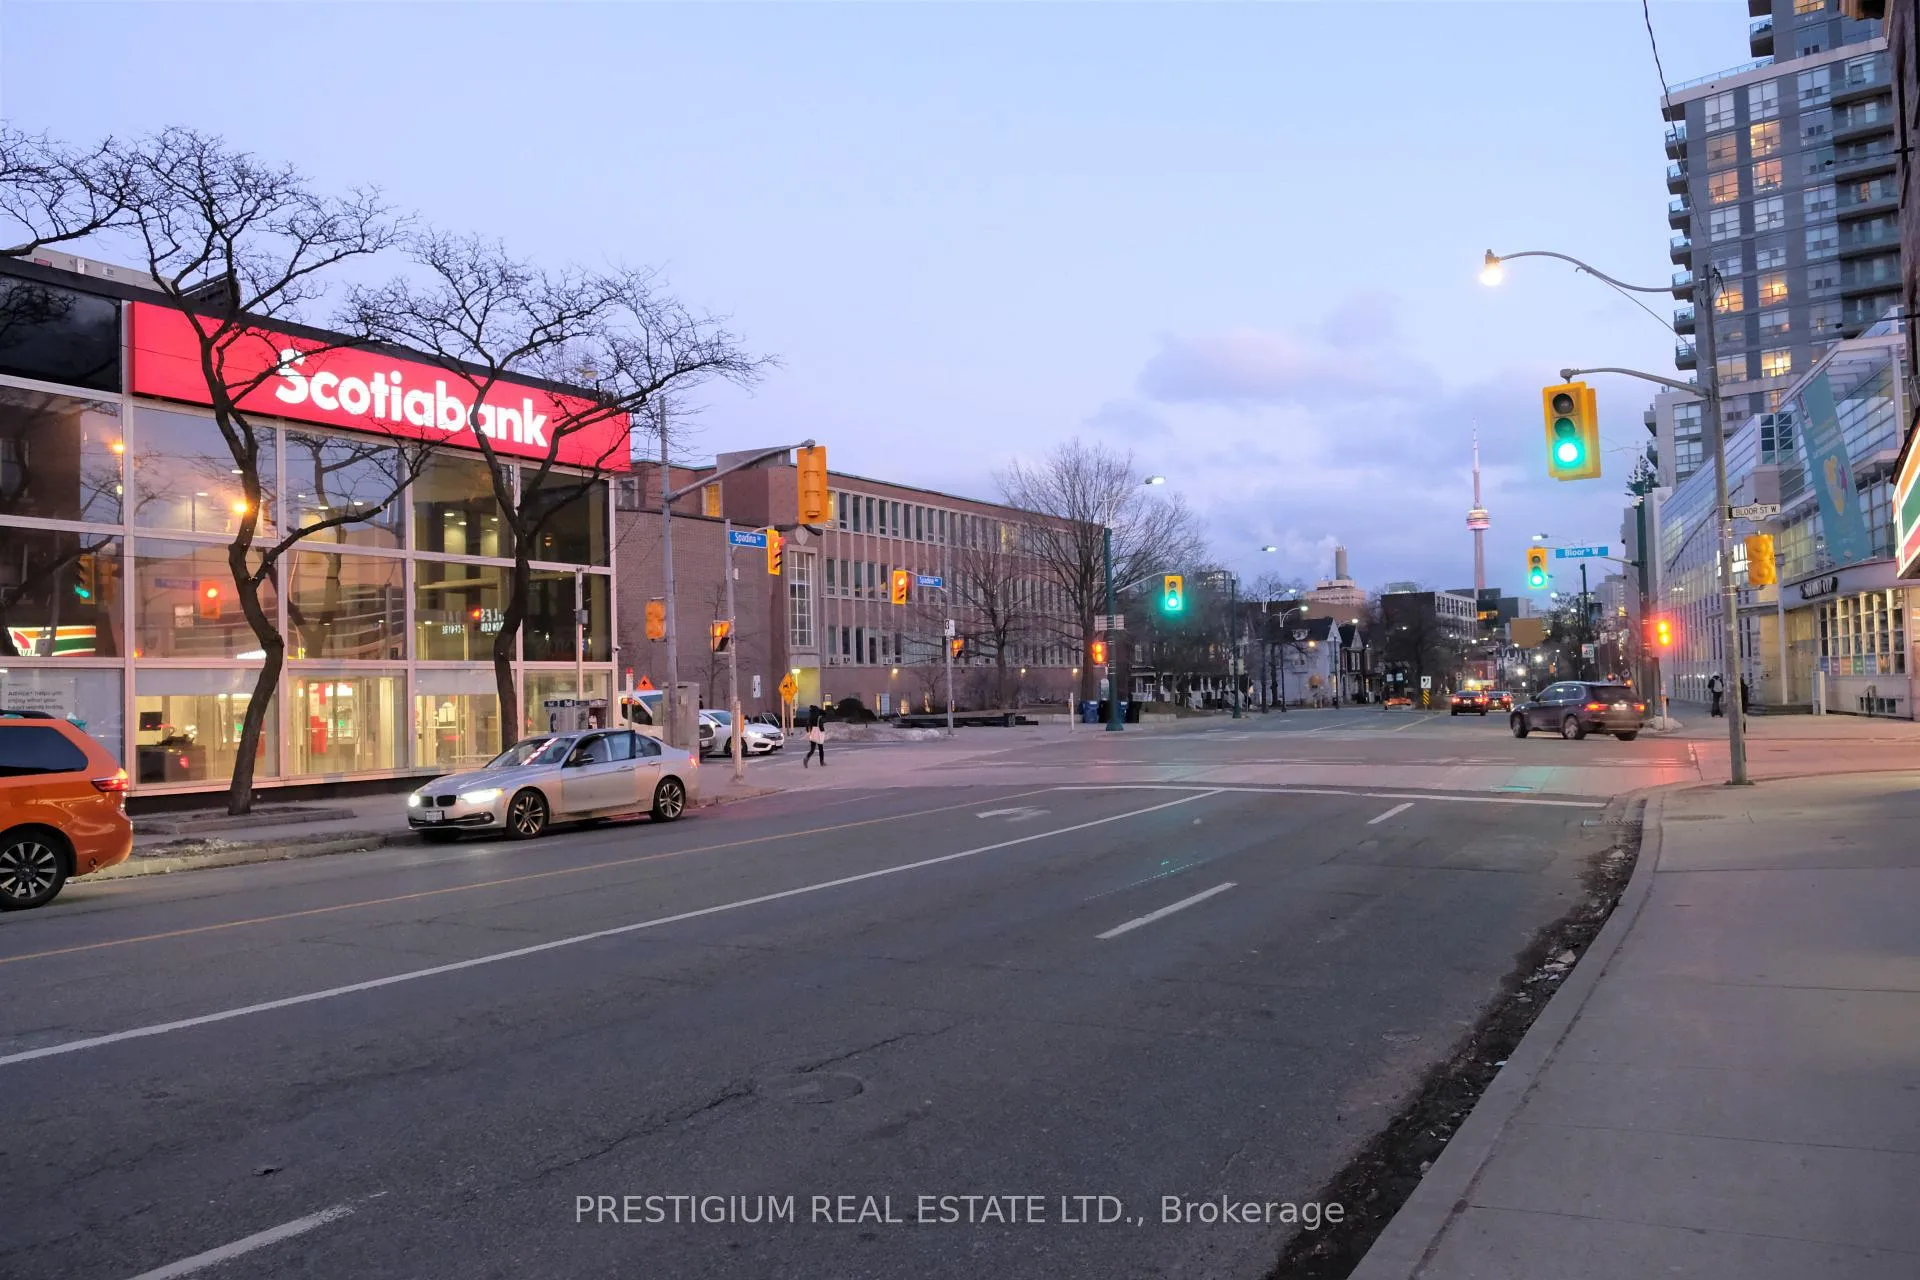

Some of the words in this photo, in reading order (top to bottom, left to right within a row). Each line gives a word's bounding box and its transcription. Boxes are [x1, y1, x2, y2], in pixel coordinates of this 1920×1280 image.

[275, 349, 548, 448] Scotiabank
[1735, 507, 1758, 517] BLOOR
[1760, 506, 1768, 514] ST
[1770, 505, 1777, 513] W
[735, 532, 757, 544] Spadina
[1564, 548, 1585, 557] Bloor
[1592, 546, 1599, 555] W
[919, 576, 935, 585] Spadina
